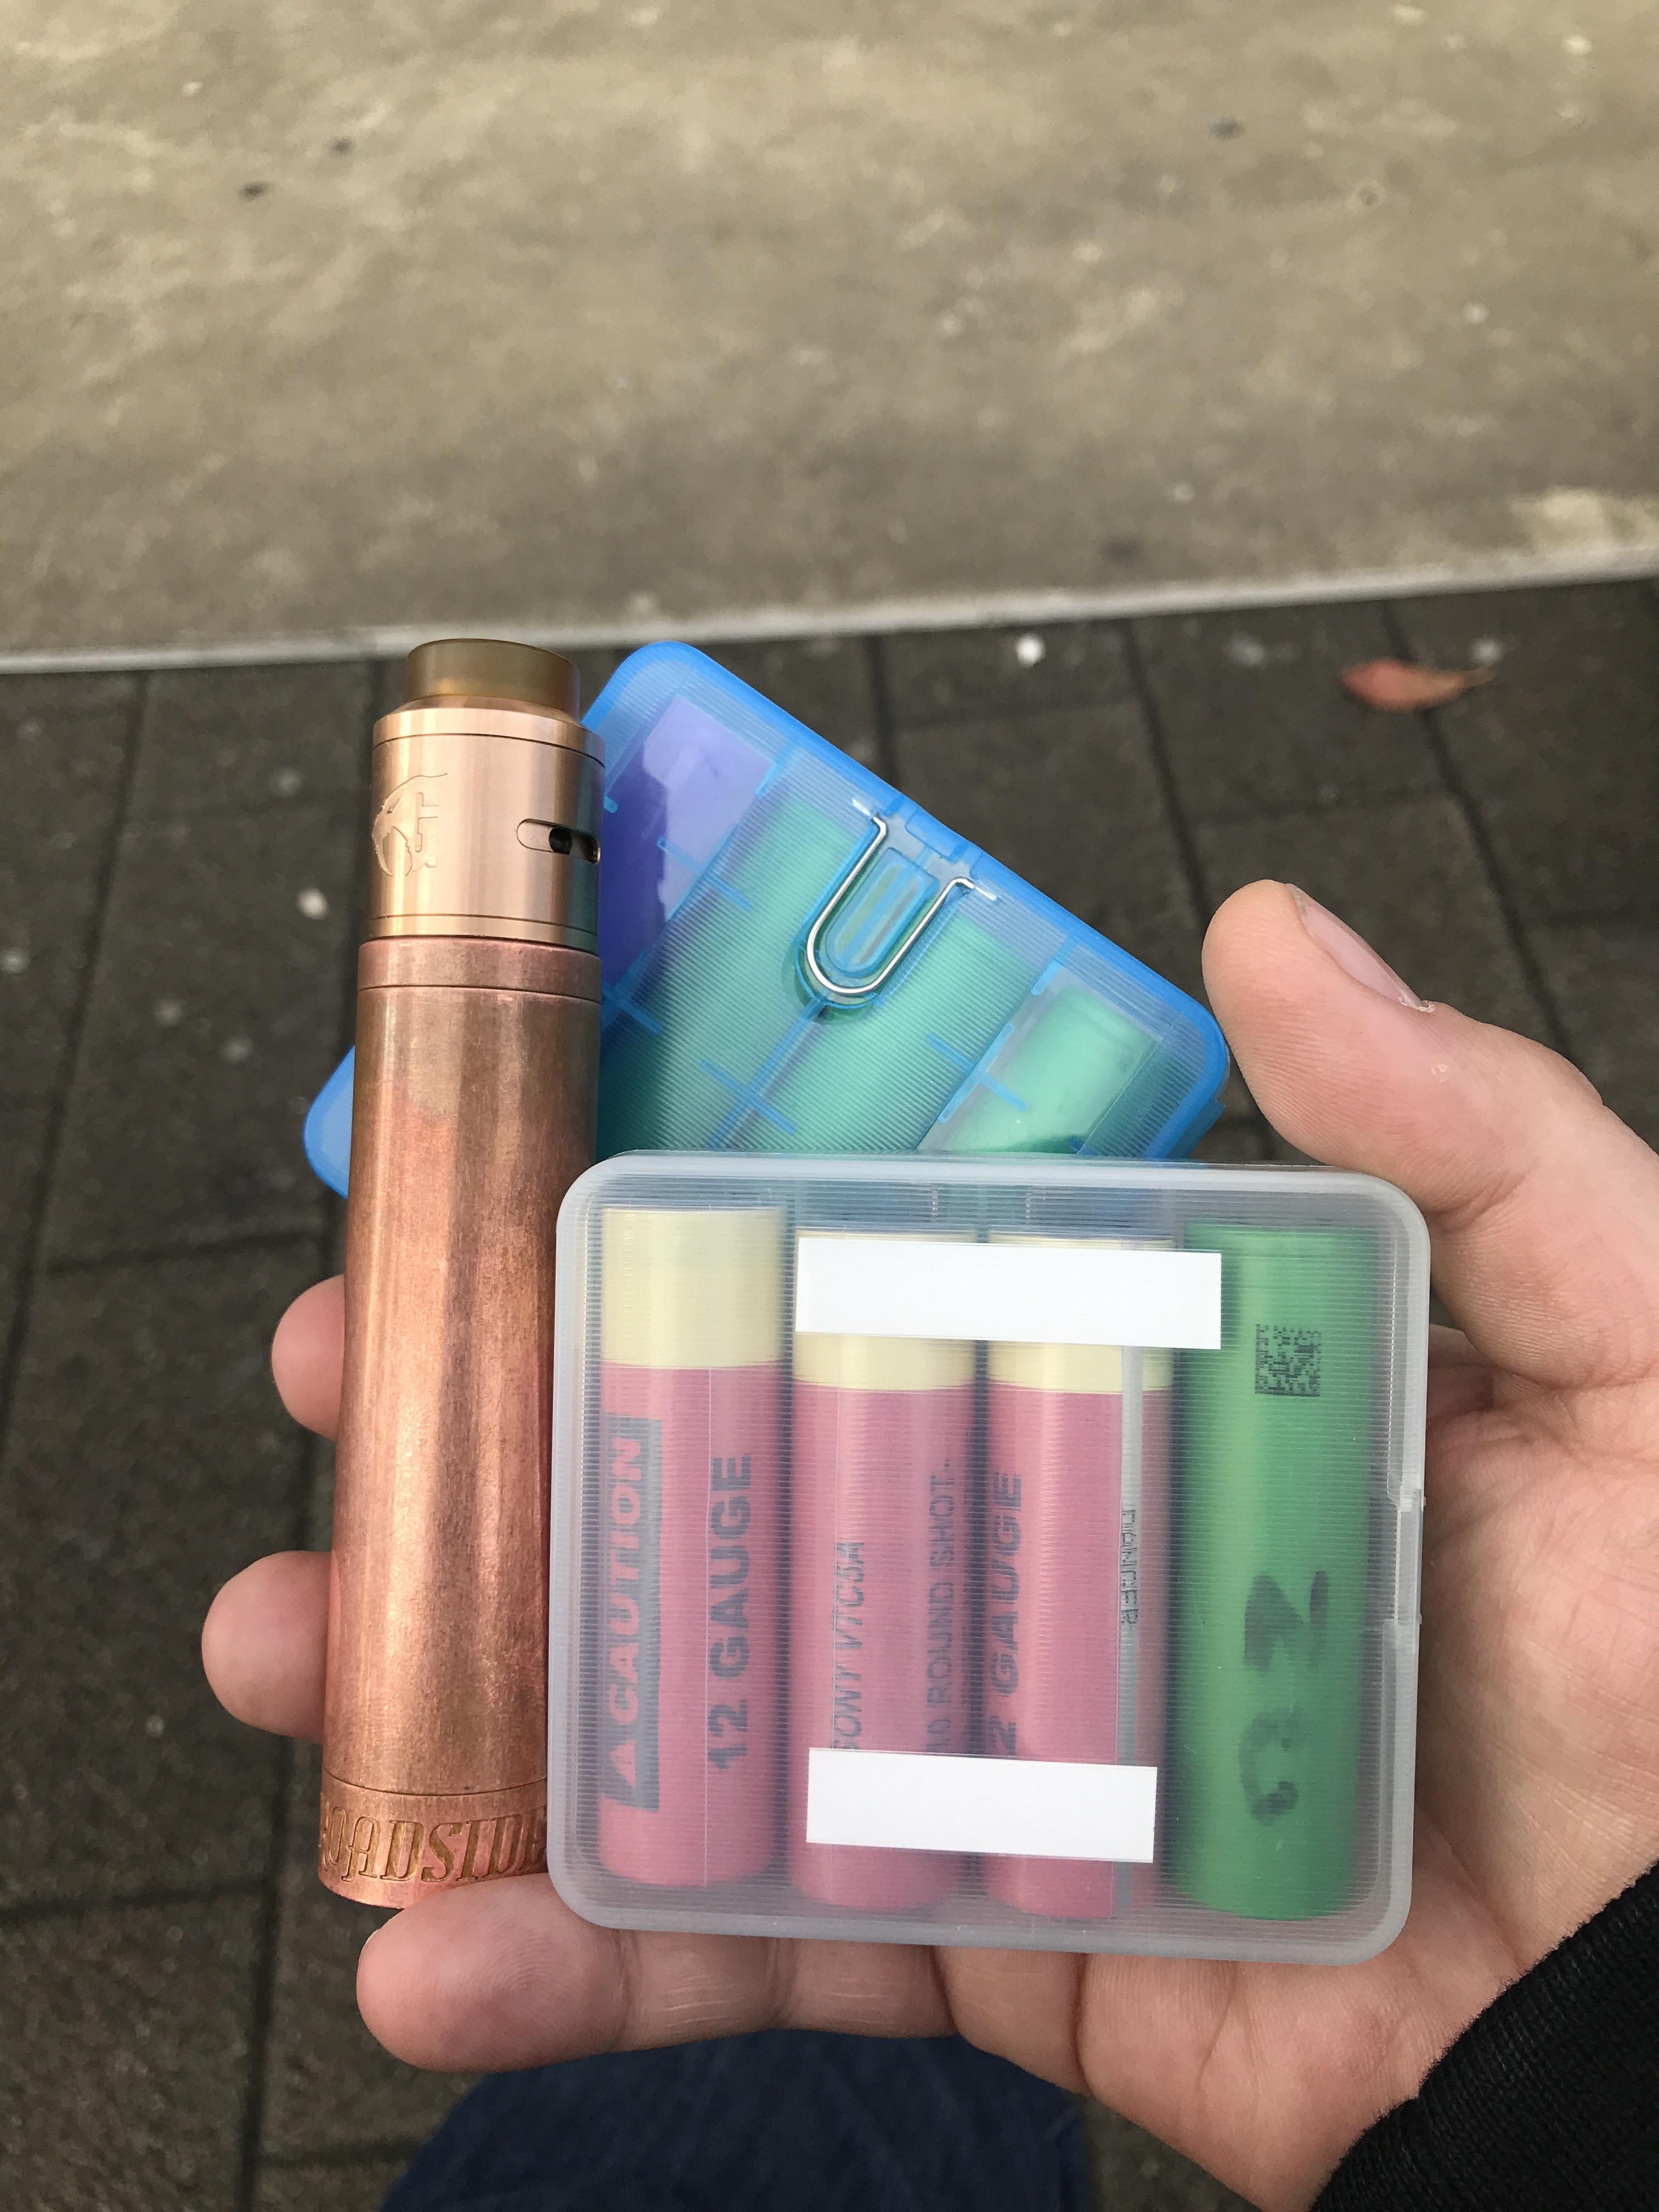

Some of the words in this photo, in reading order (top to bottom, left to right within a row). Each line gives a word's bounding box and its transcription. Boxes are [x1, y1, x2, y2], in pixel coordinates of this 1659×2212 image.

[610, 1436, 642, 1725] CAUTION
[710, 1454, 752, 1679] GAUGE
[833, 1542, 865, 1650] VTC5A
[926, 1582, 954, 1708] ROUND
[991, 1472, 1022, 1695] GAUGE
[708, 1699, 748, 1773] 12
